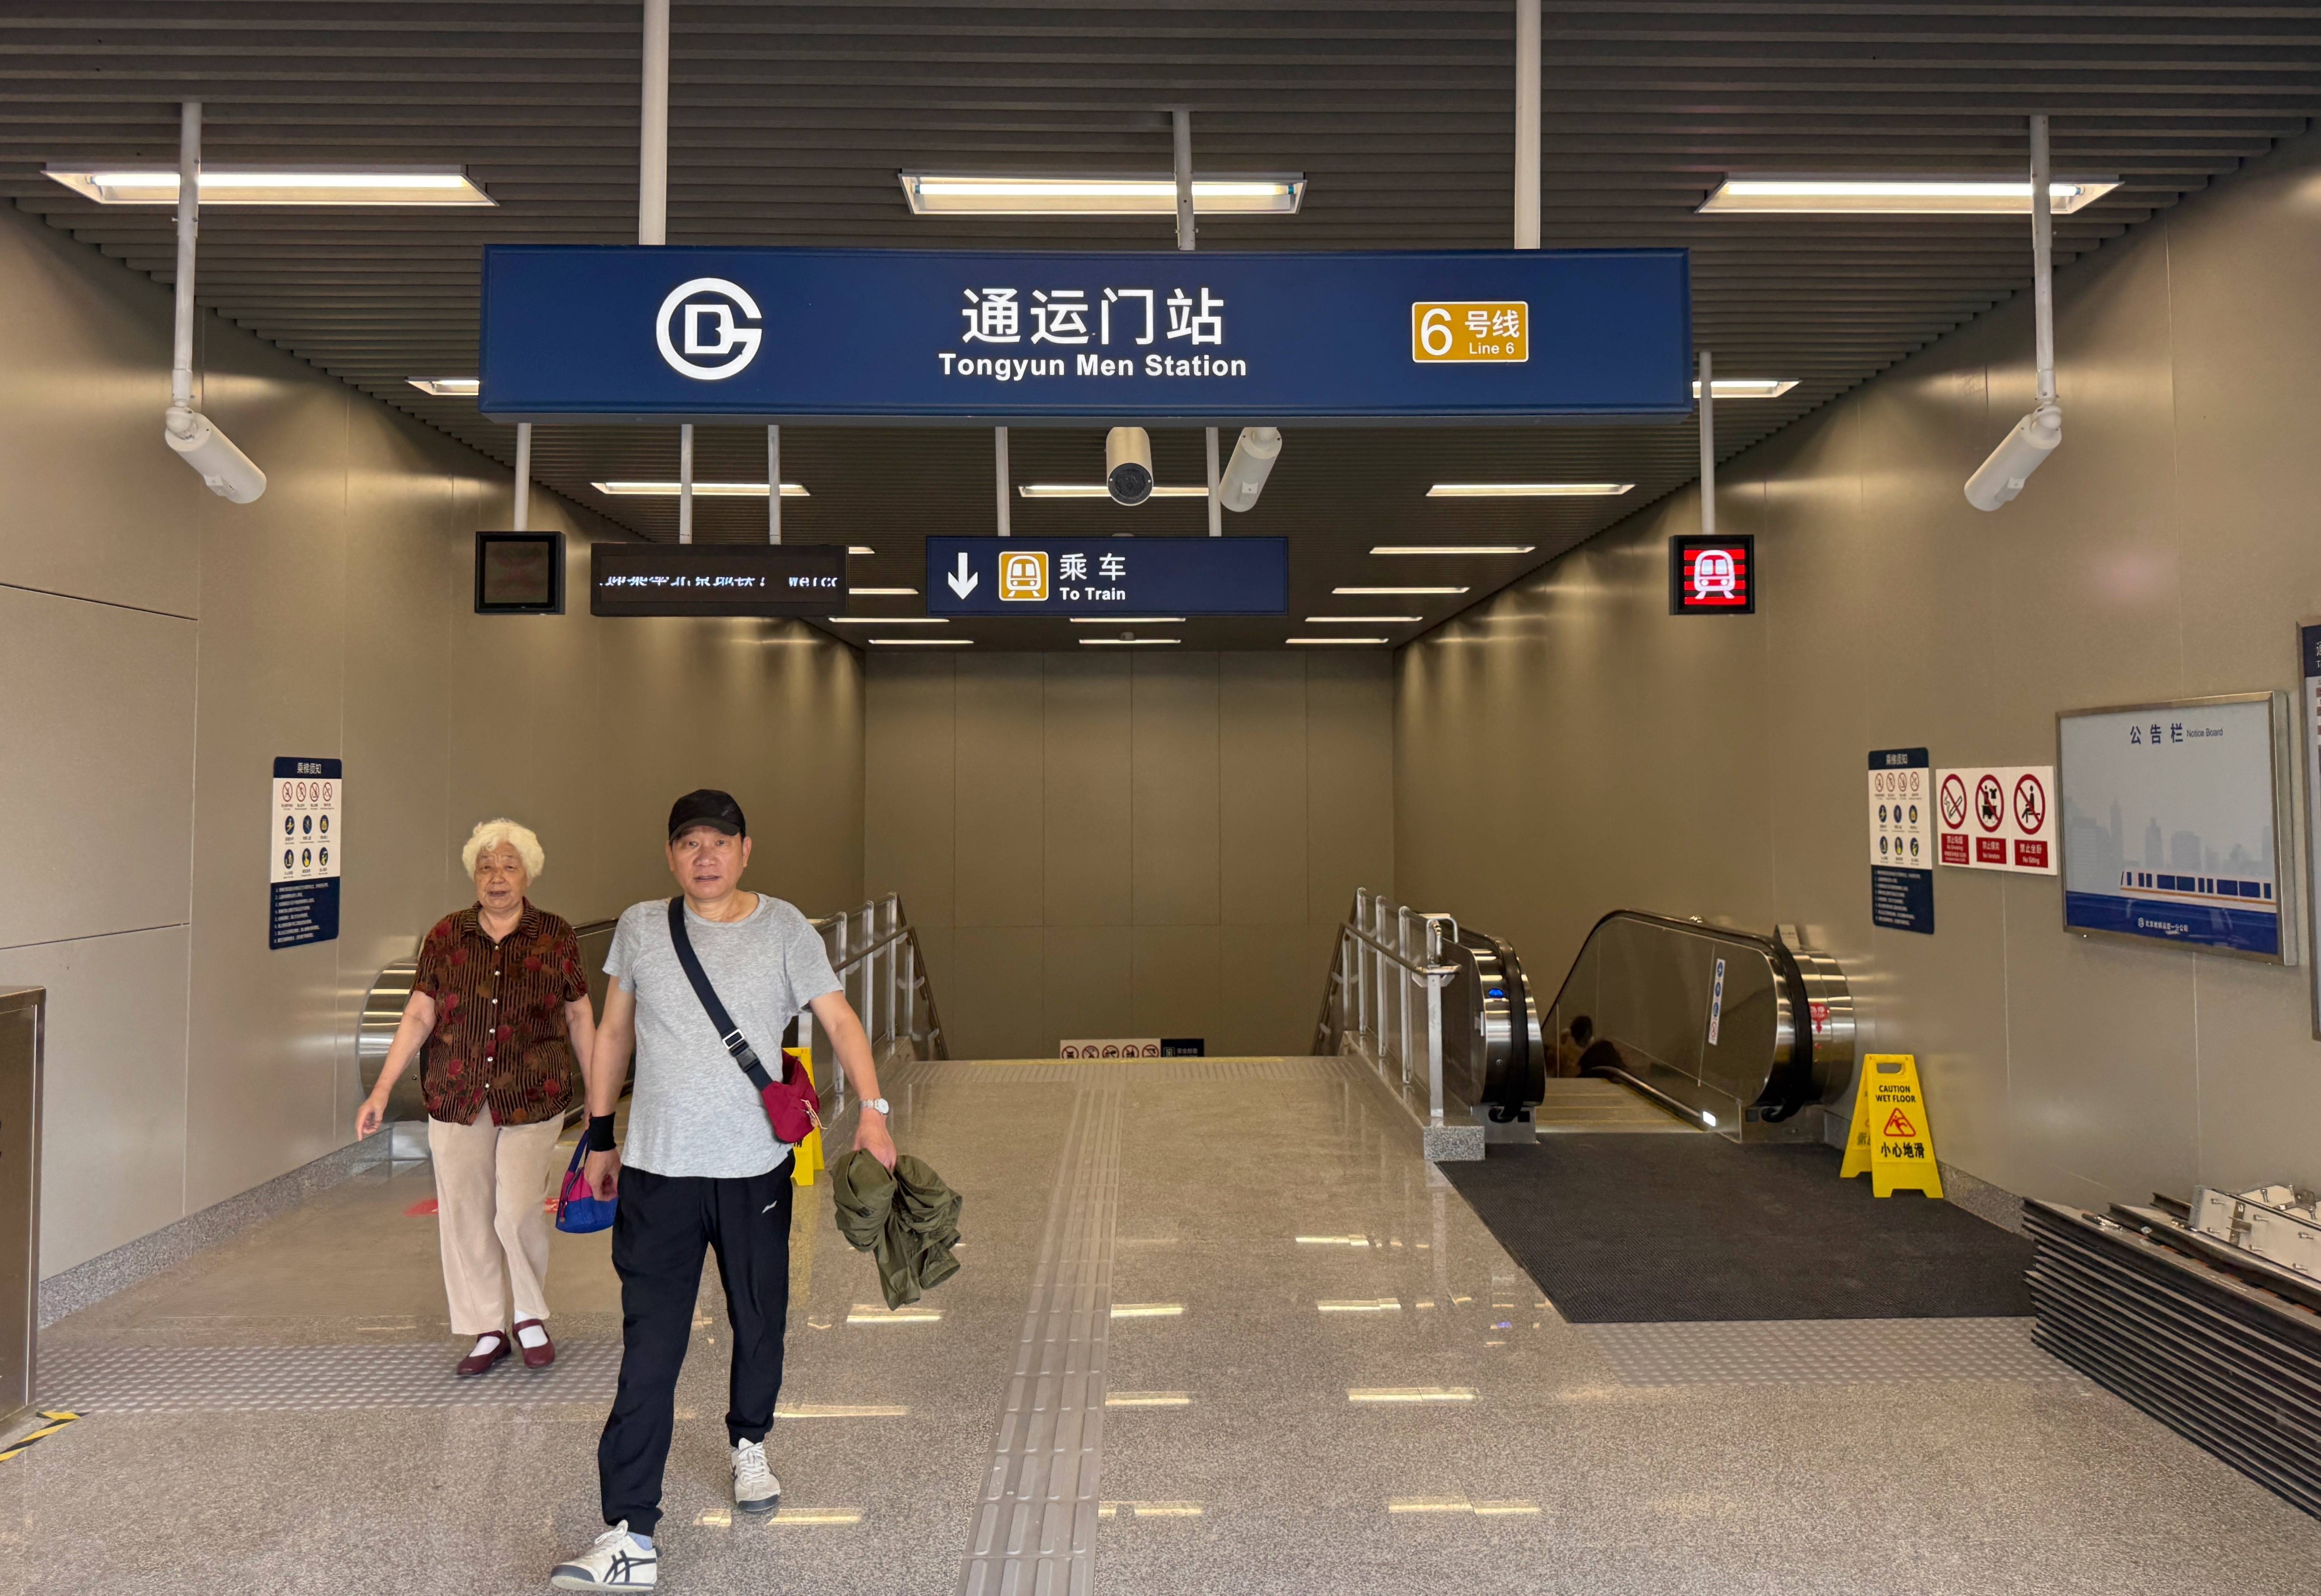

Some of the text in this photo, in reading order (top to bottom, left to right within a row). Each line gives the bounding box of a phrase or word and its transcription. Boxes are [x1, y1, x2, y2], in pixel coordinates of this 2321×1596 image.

[962, 288, 1224, 345] 通运门站
[1421, 308, 1520, 356] 6 号线
[1469, 342, 1515, 354] Line 6
[939, 353, 1246, 381] Tongyun Men Station
[1059, 552, 1127, 581] 乘车
[1059, 587, 1126, 601] To Train
[2130, 722, 2183, 744] 公告栏
[2187, 728, 2223, 737] Notice Board
[1879, 1085, 1911, 1093] CAUTION
[1893, 1095, 1916, 1103] FLOOR
[1881, 1141, 1925, 1159] 小心地滑
